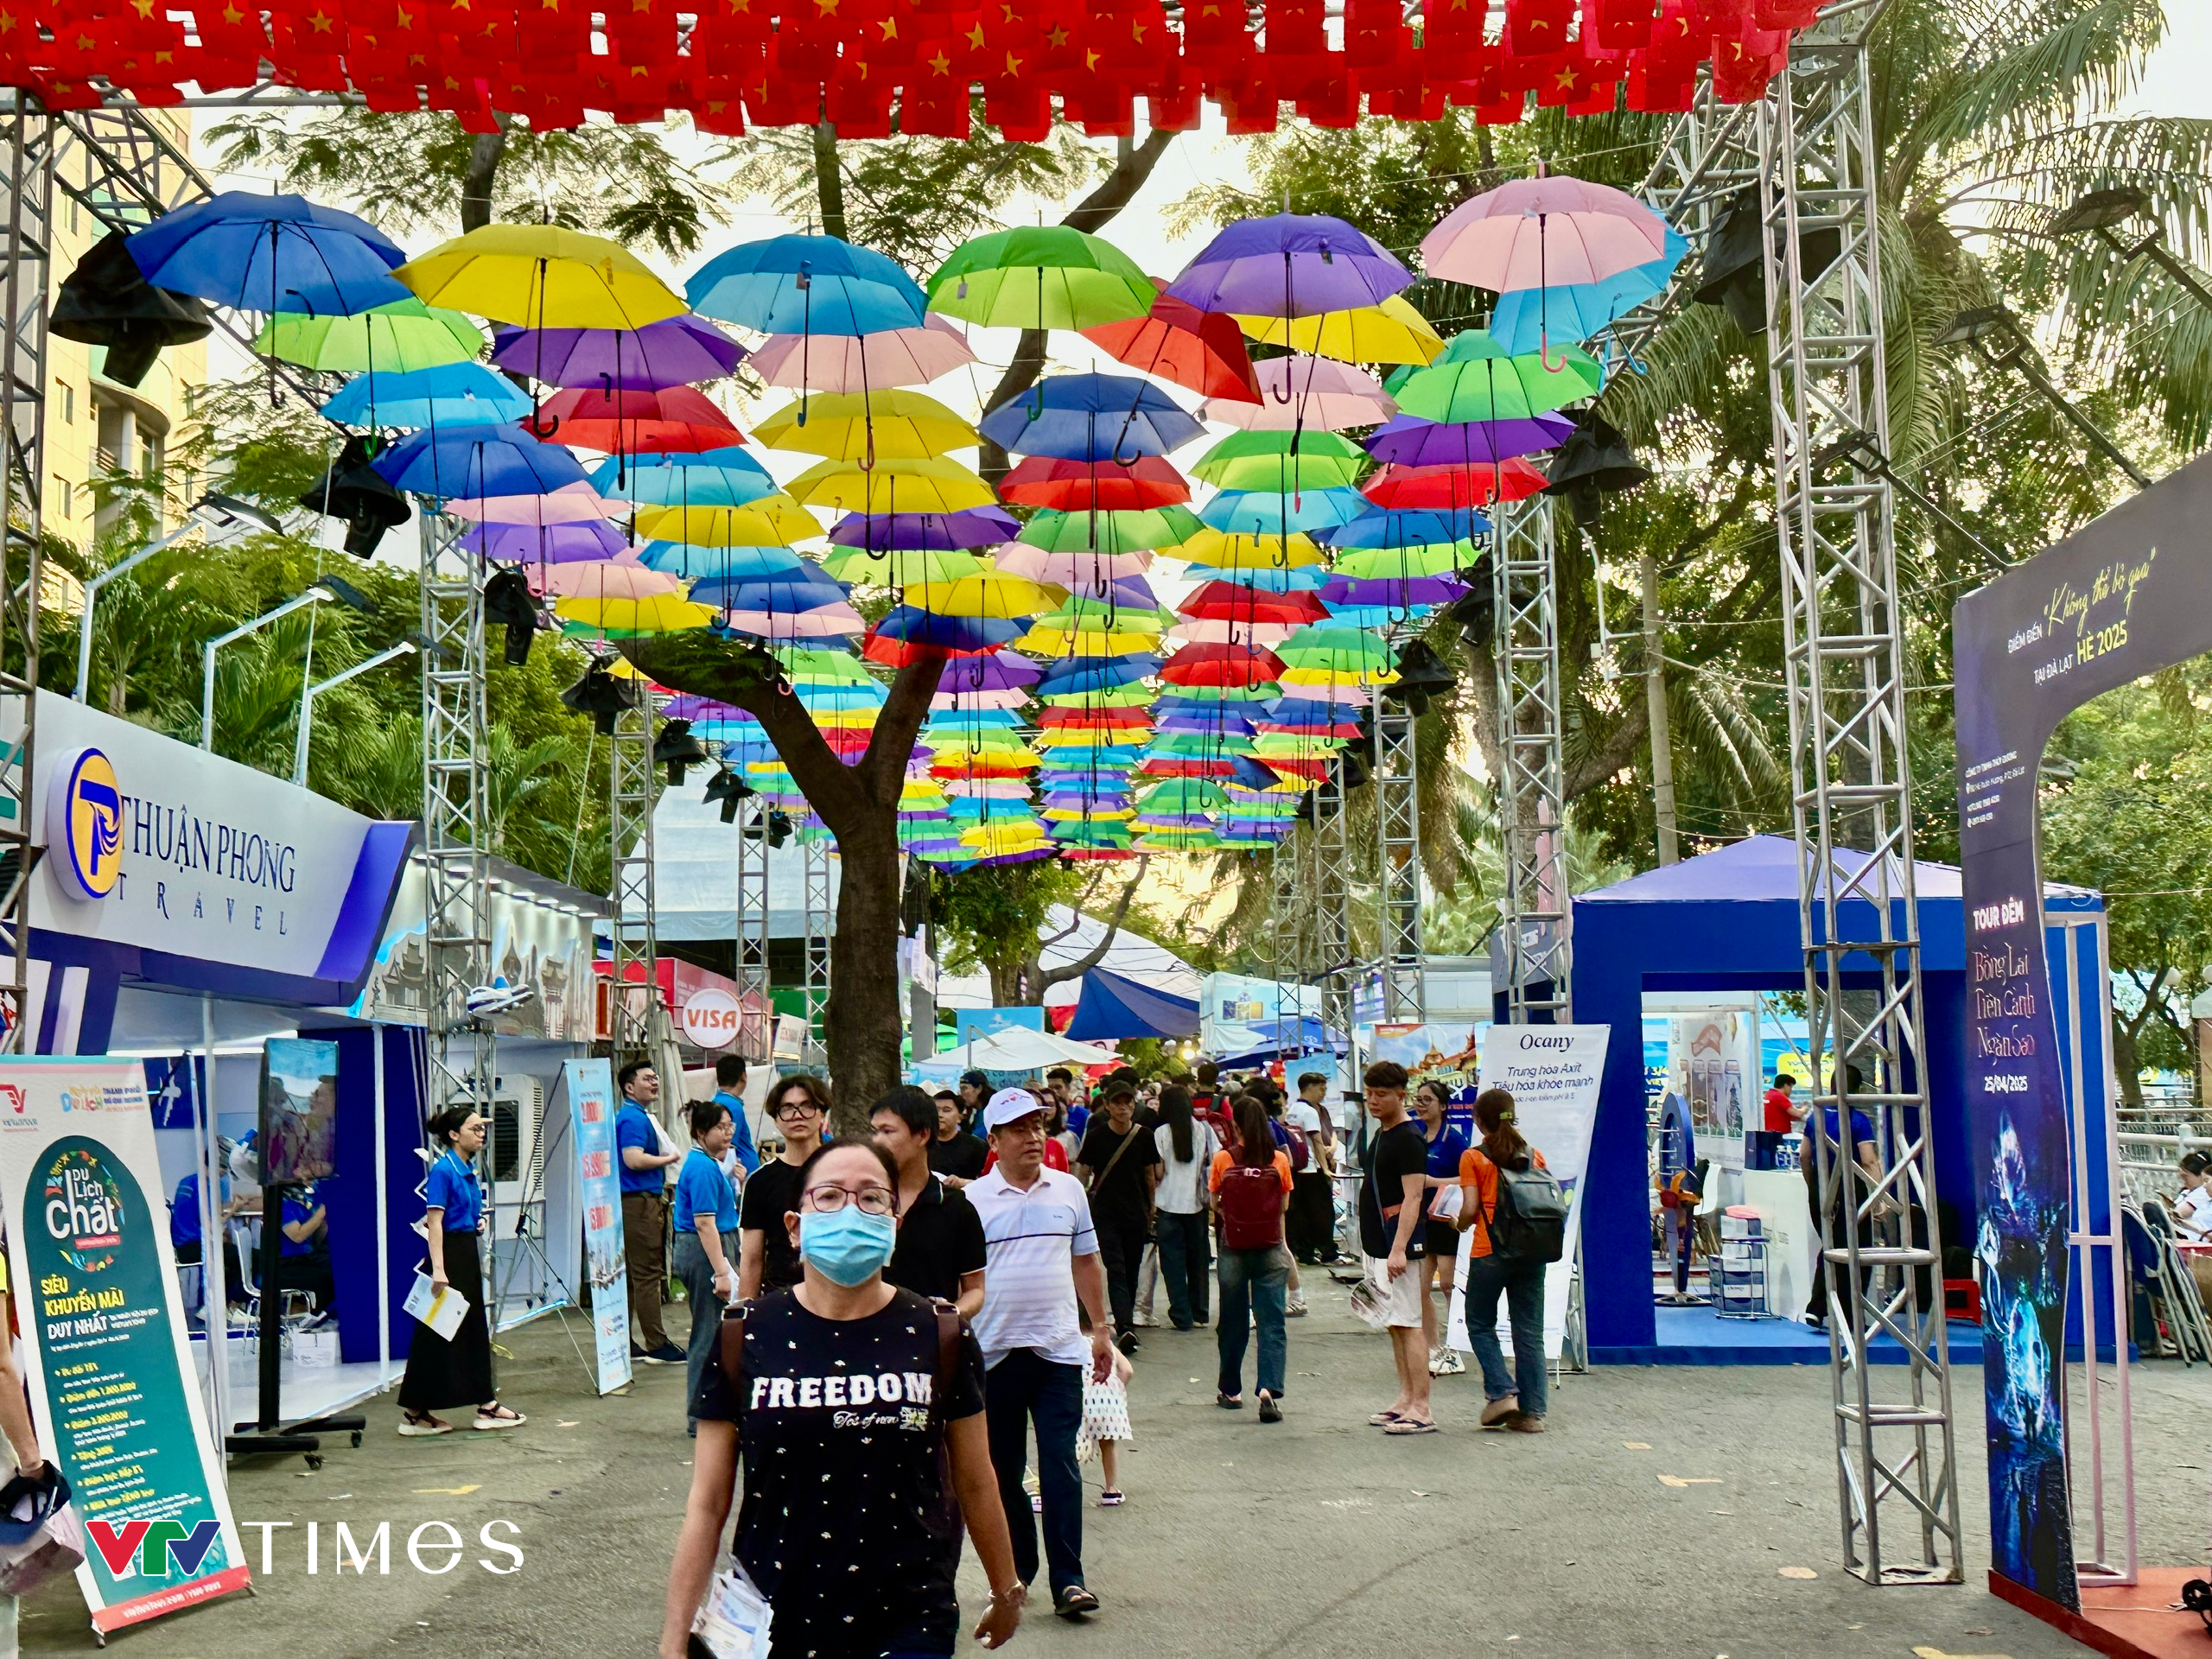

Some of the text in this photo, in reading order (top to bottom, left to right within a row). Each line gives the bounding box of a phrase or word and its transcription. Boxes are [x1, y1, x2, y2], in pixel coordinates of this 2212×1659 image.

[2076, 630, 2095, 665] HÈ
[2096, 619, 2128, 656] 2025
[216, 823, 296, 893] PHONG
[1973, 906, 2000, 931] TOUR
[2004, 941, 2029, 977] Lai
[686, 1007, 737, 1030] VISA
[1519, 1033, 1574, 1053] Ocany
[2012, 1024, 2036, 1057] Sao
[1508, 1066, 1537, 1078] Trung
[1564, 1076, 1594, 1090] mạnh
[47, 1319, 73, 1340] DUY
[75, 1310, 108, 1336] NHẤT
[751, 1371, 933, 1410] FREEDOM
